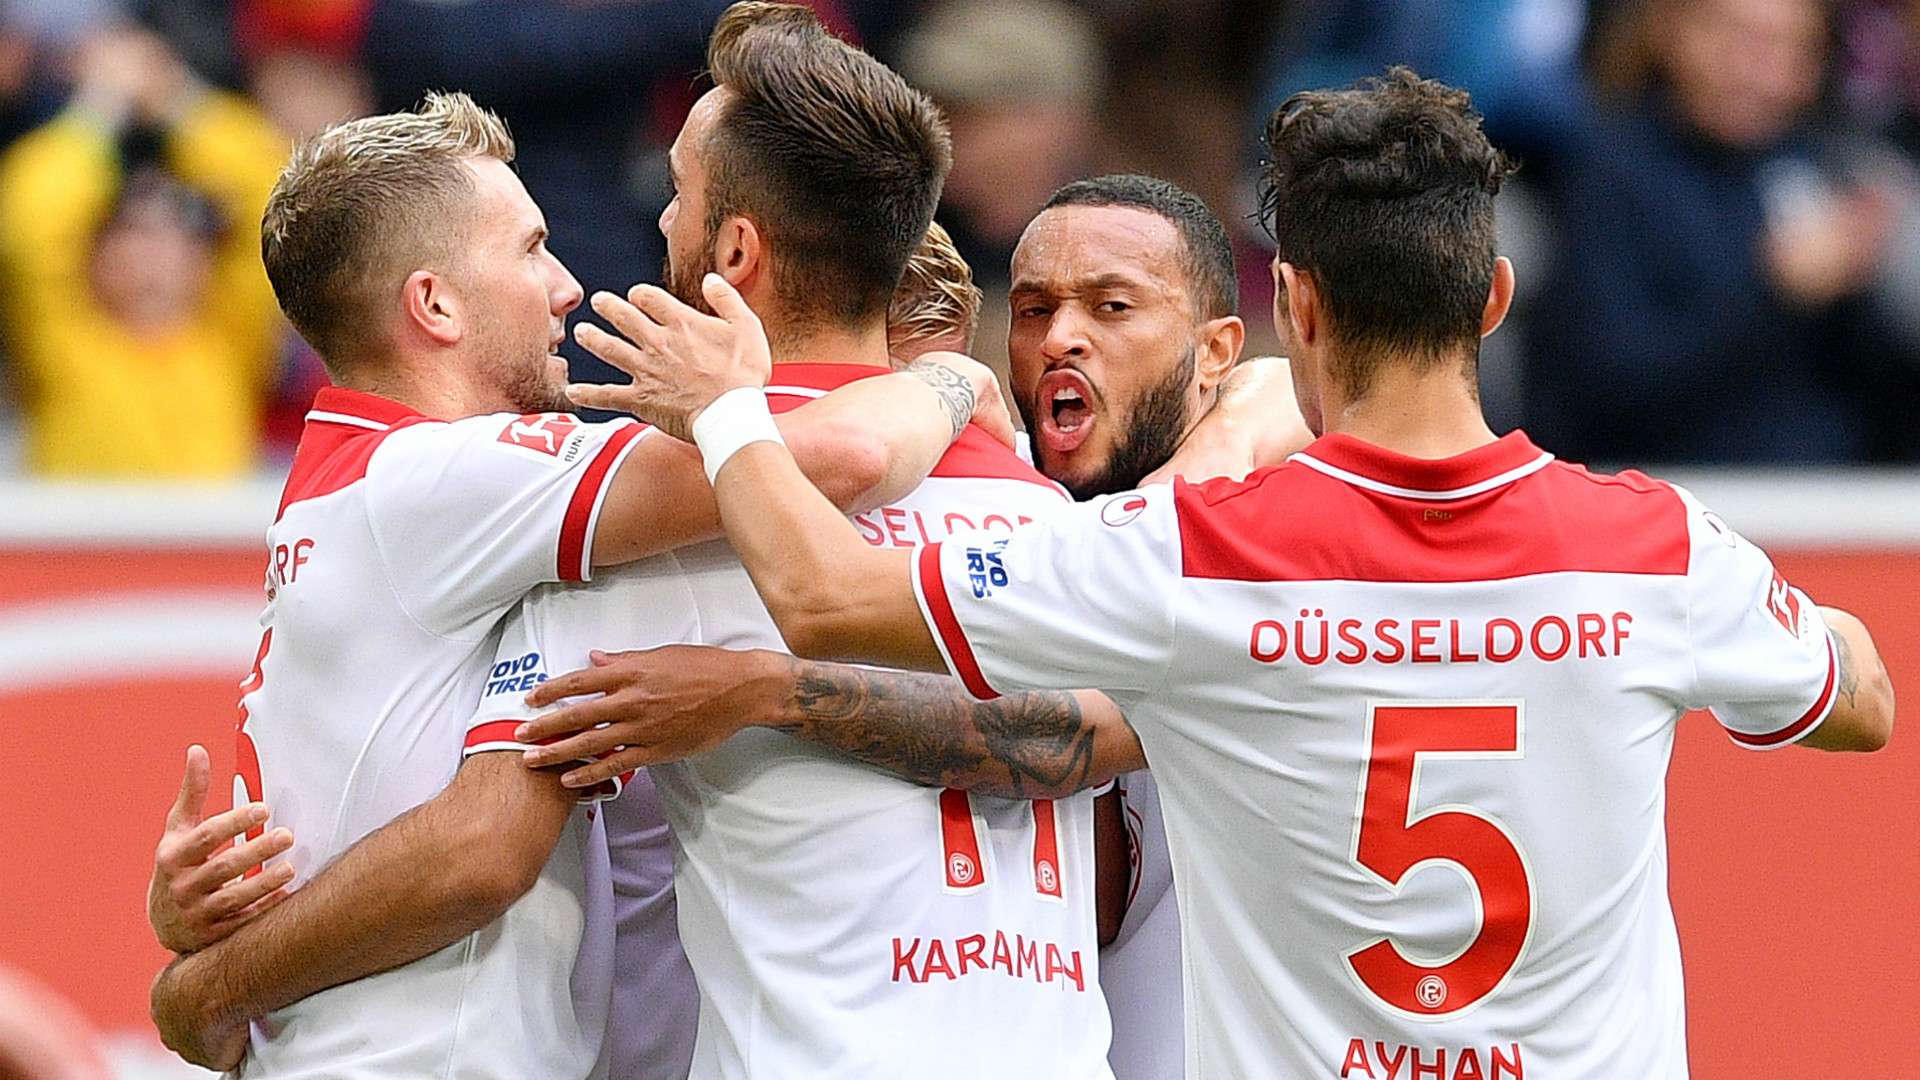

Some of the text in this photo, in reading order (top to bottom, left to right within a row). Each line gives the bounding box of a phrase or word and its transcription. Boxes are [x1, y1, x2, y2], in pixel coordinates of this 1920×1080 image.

[1249, 609, 1633, 665] DÜSSELDORF
[491, 653, 540, 678] OYO
[1345, 703, 1535, 1018] 5
[891, 930, 1085, 992] KARAMAN
[1340, 1039, 1523, 1080] AYHAN
